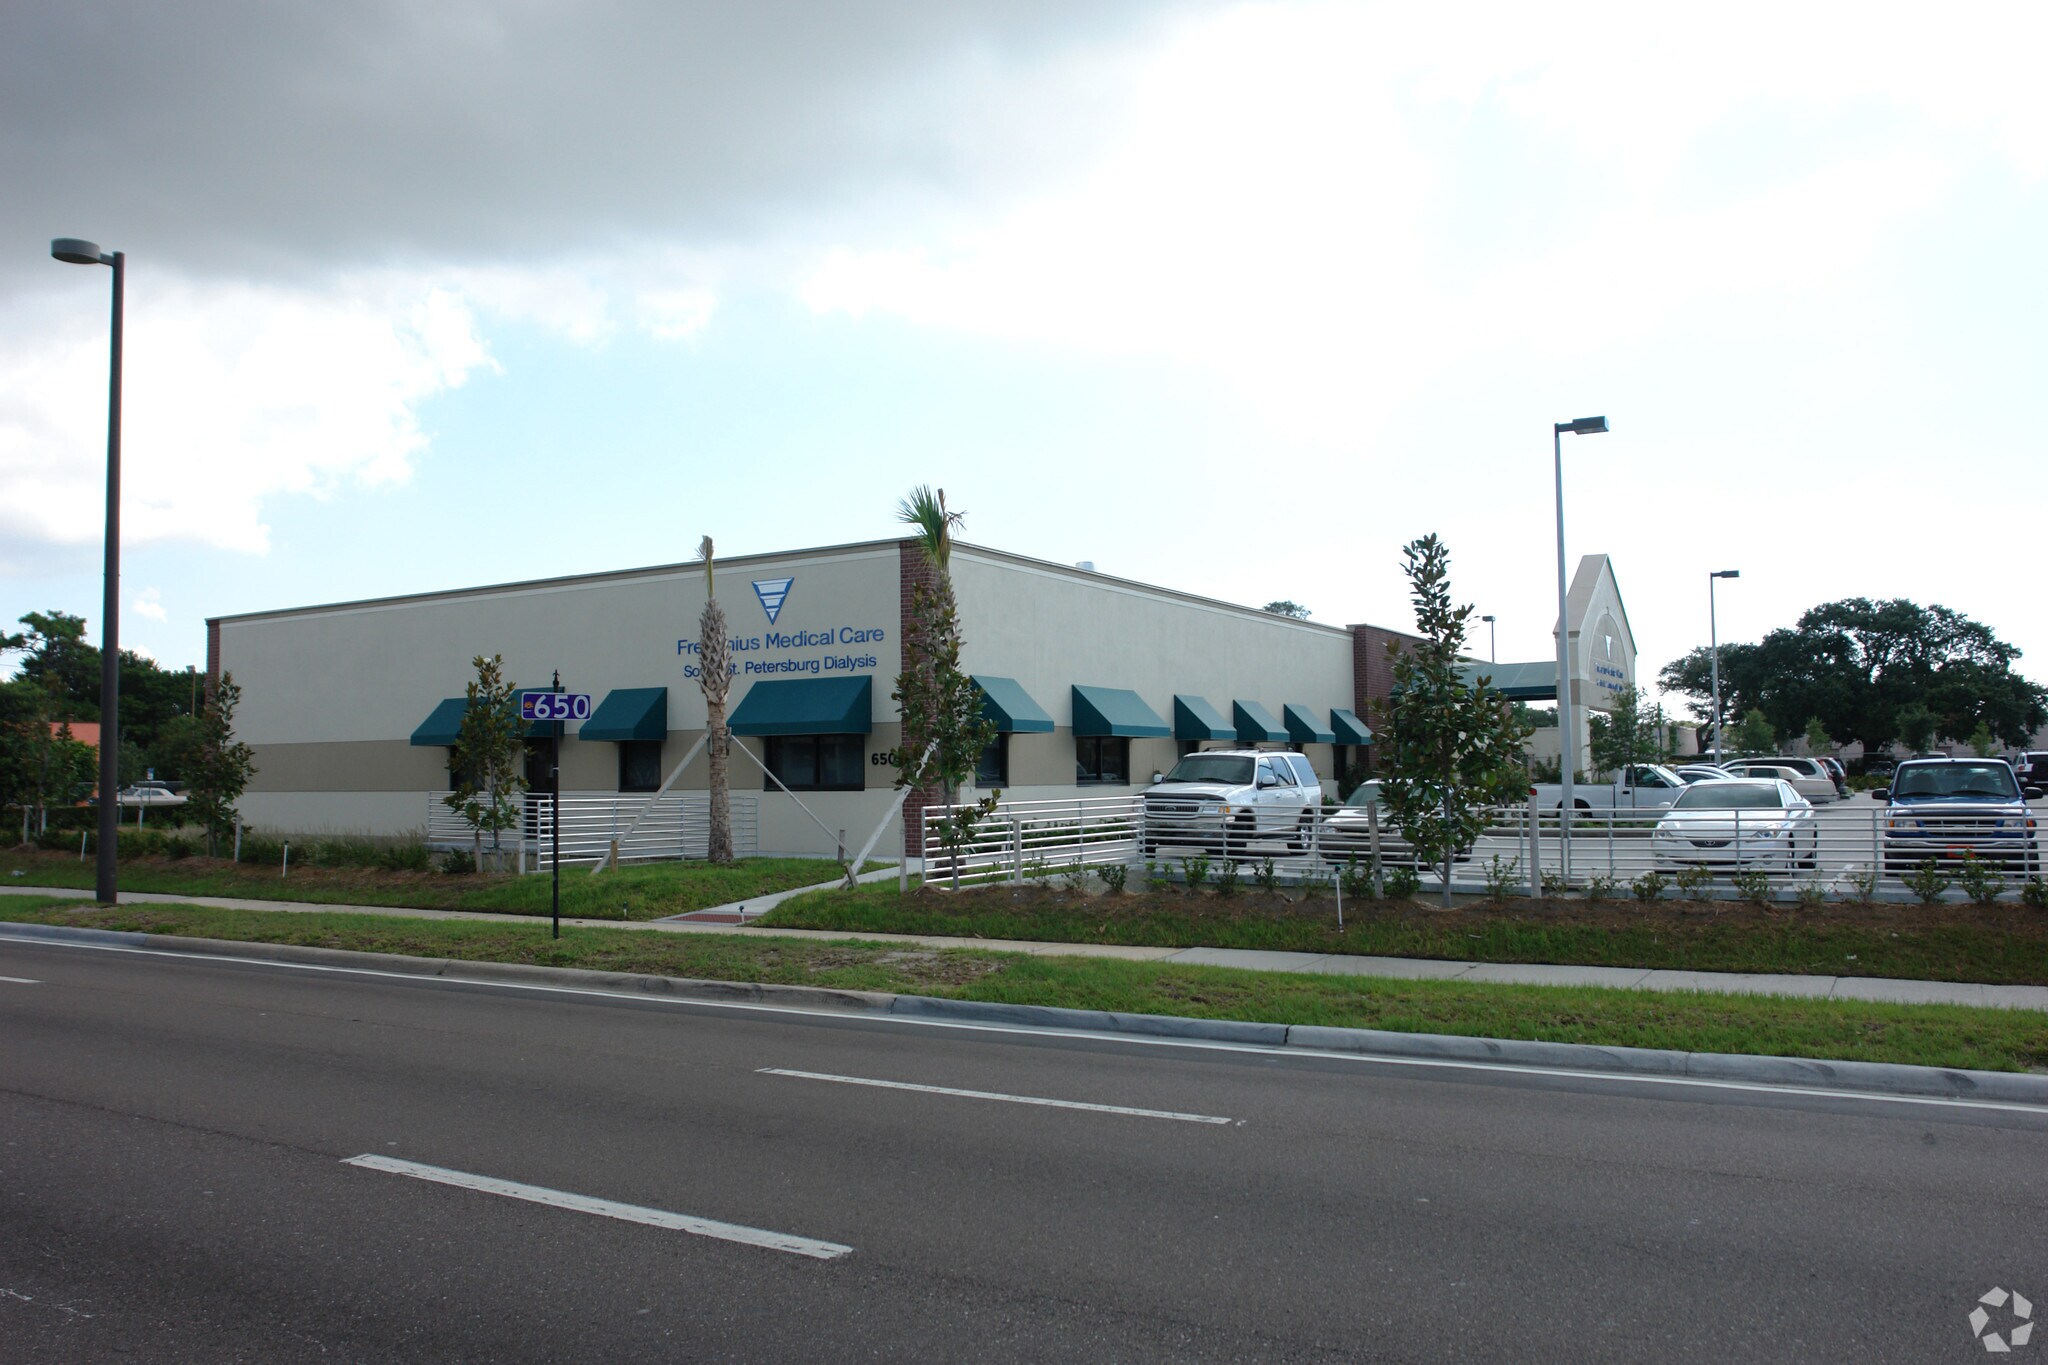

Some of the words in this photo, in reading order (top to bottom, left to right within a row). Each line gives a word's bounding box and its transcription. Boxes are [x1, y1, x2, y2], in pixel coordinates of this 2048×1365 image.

[677, 635, 760, 655] Frenius
[766, 628, 835, 649] Medical
[839, 627, 885, 644] Care
[745, 658, 820, 674] Petersburg
[824, 653, 877, 671] Dialysis
[534, 694, 589, 719] 650
[871, 753, 895, 766] 650
